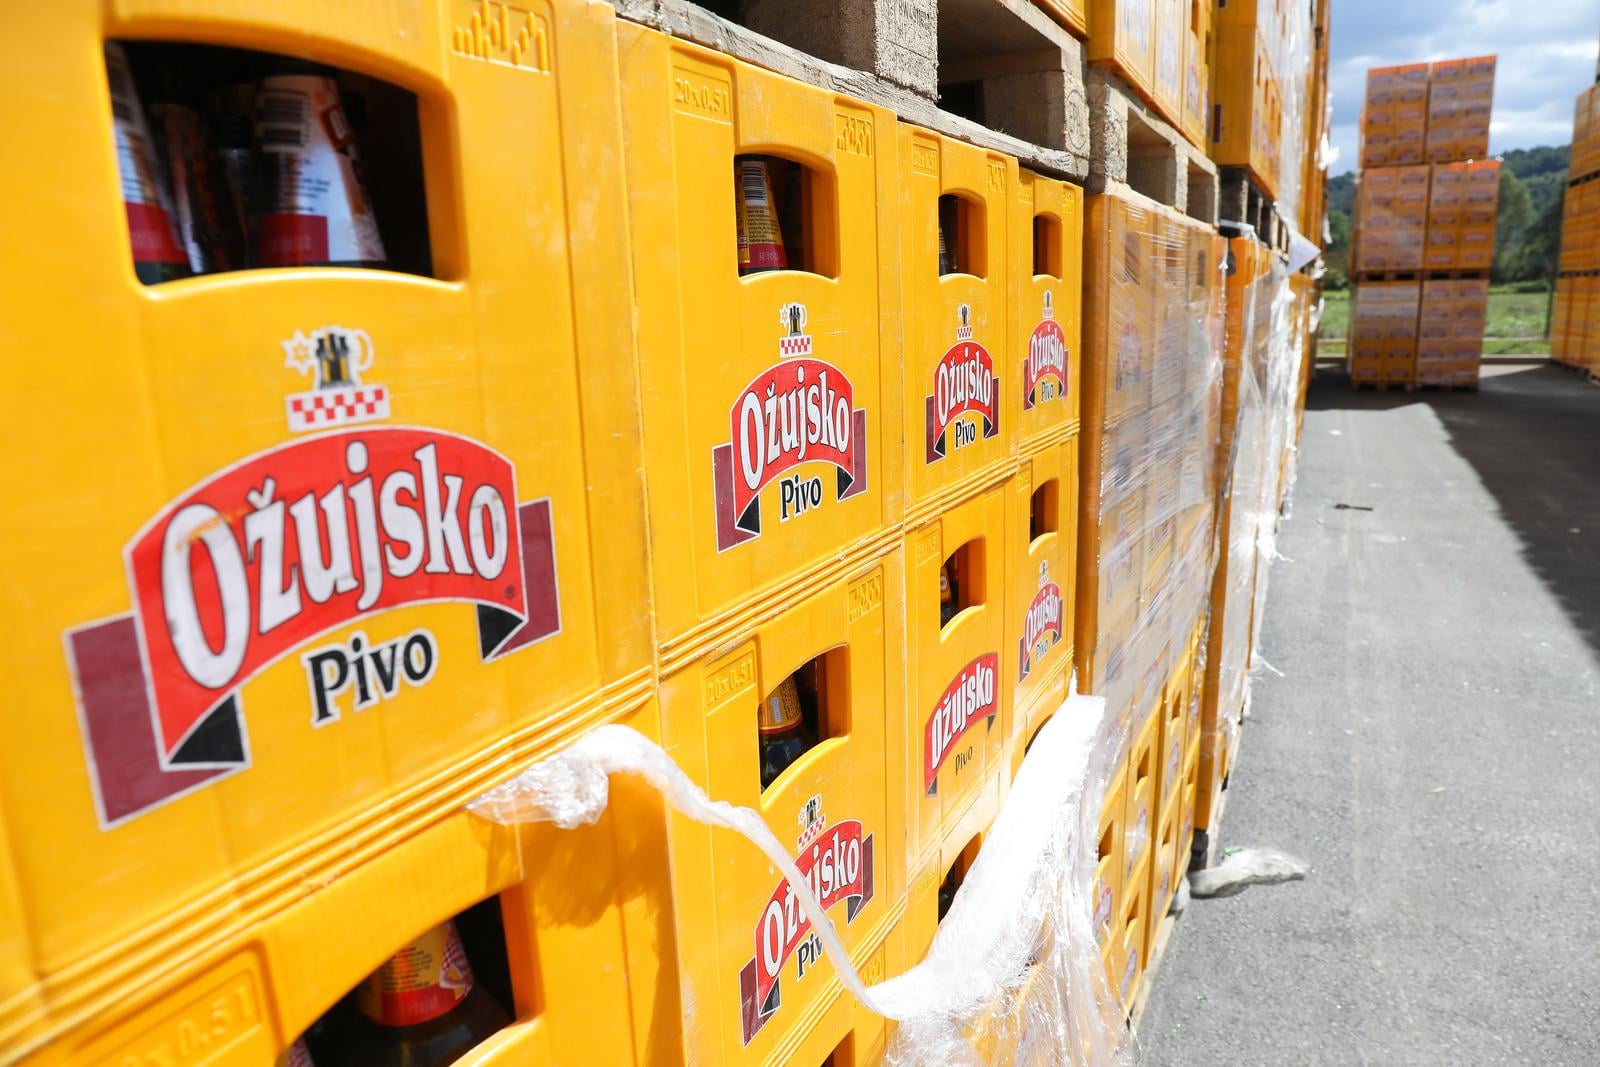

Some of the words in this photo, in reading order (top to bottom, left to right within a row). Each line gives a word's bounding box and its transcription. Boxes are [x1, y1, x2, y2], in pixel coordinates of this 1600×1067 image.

[937, 346, 991, 427] Ožujsko
[740, 365, 850, 490] Ožujsko
[955, 418, 976, 448] Pivo
[780, 473, 822, 520] Pivo
[161, 440, 509, 690] Ožujsko
[307, 633, 435, 723] Pivo
[931, 662, 994, 770] Ožujsko
[955, 746, 973, 776] Pivo
[797, 933, 823, 978] Piv
